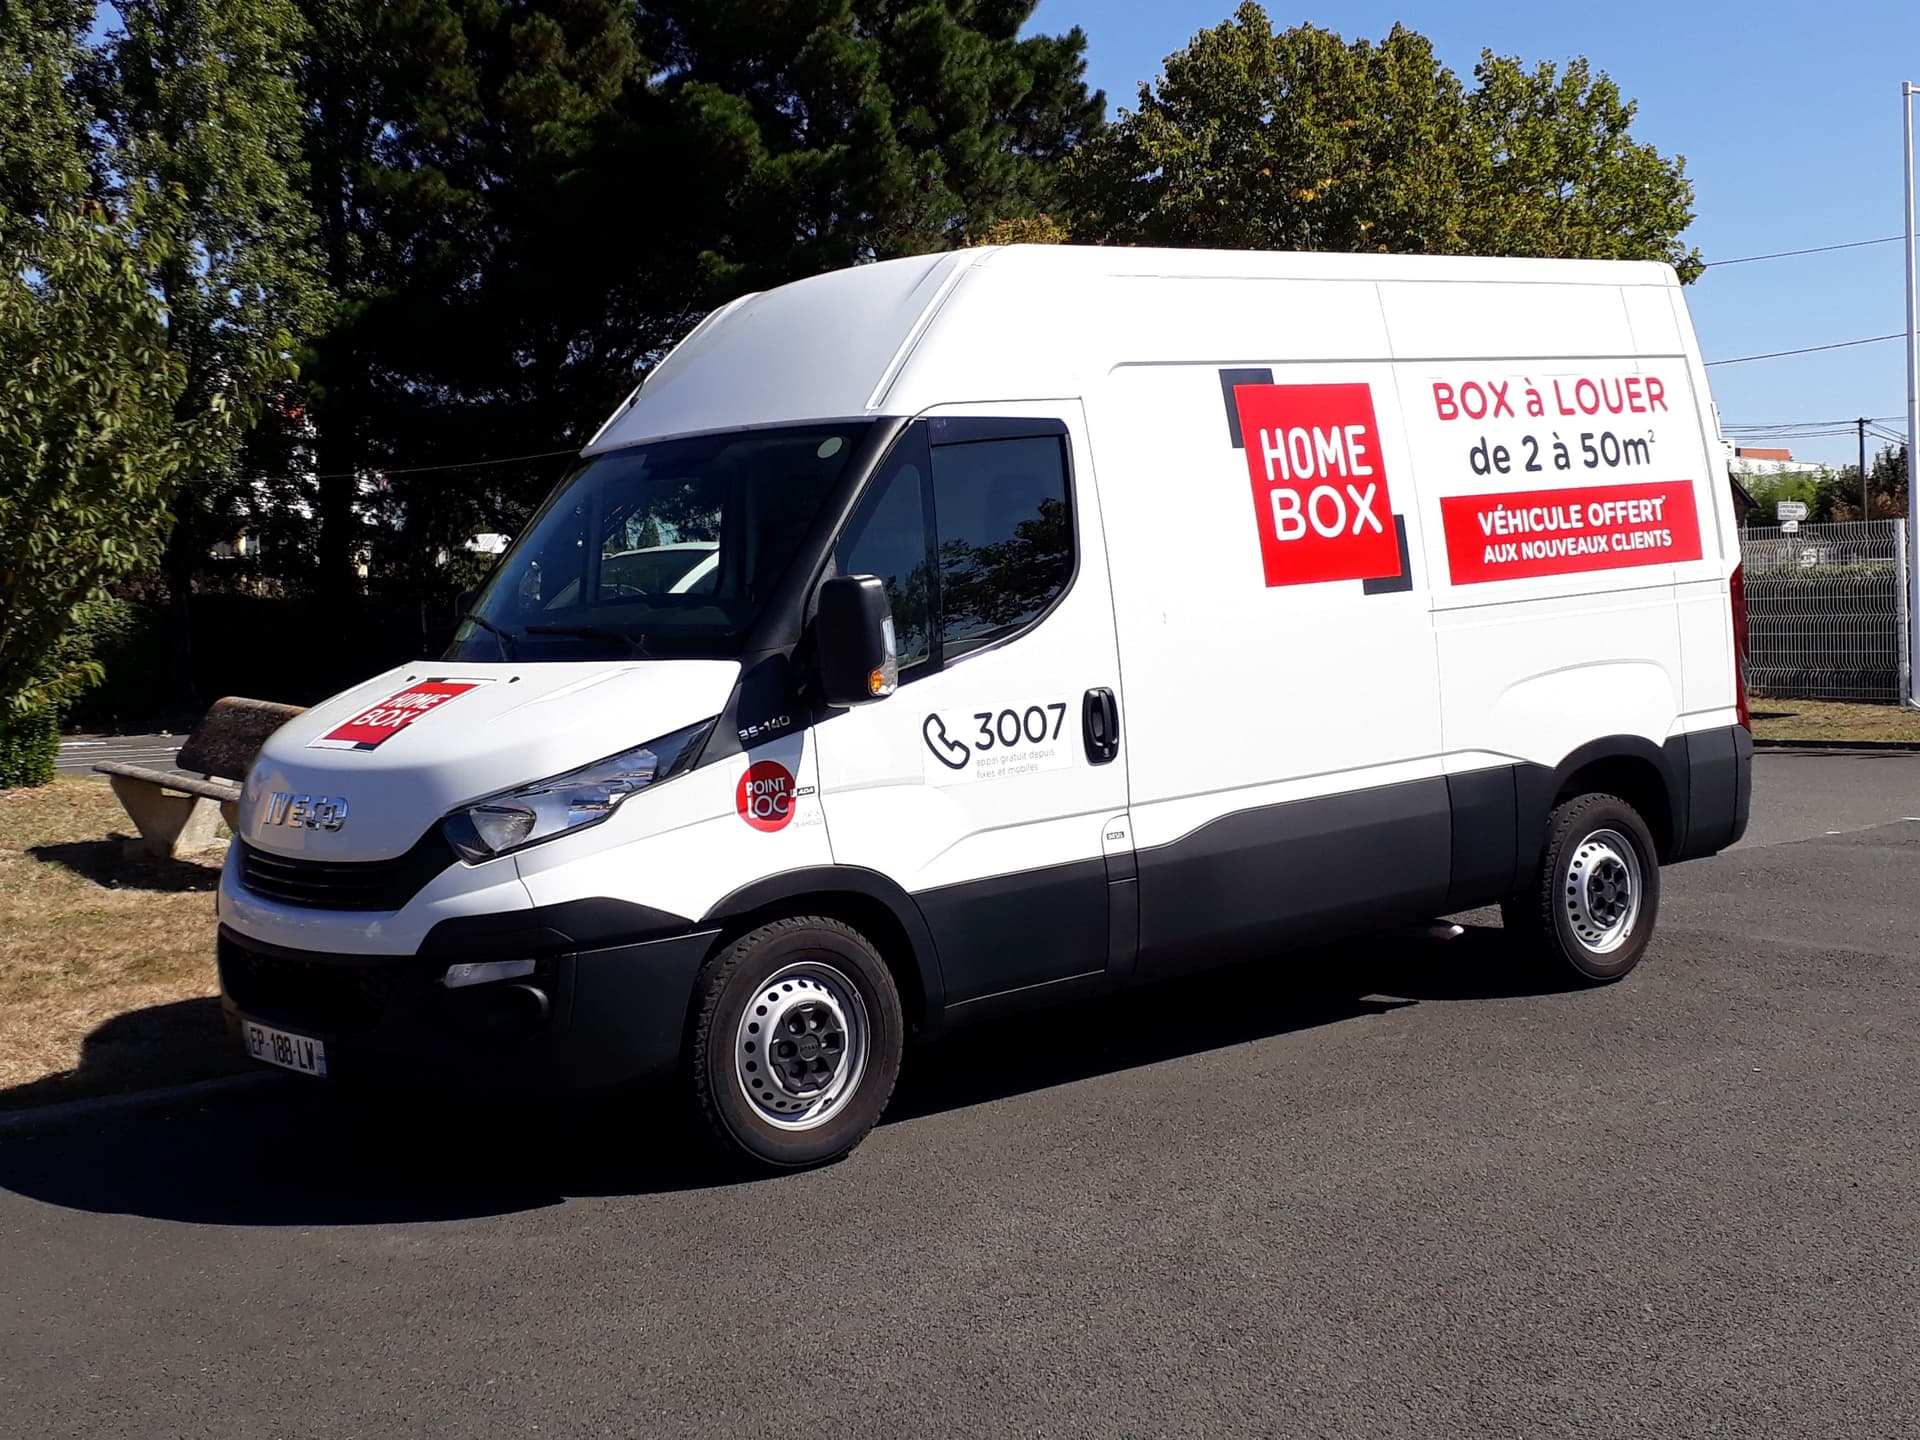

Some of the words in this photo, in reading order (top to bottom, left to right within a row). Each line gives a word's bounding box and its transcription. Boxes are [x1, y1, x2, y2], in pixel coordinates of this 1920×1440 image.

[1432, 381, 1515, 420] BOX
[1524, 377, 1544, 417] à
[1553, 377, 1668, 415] LOUER
[1260, 424, 1374, 481] HOME
[1469, 436, 1511, 475] de
[1522, 435, 1542, 472] 2
[1553, 432, 1571, 470] à
[1270, 482, 1382, 541] BOX
[1477, 503, 1584, 536] VÉHICULE
[1484, 543, 1519, 564] AUX
[1521, 535, 1609, 560] NOUVEAUX
[1611, 529, 1672, 551] CLIENTS
[352, 709, 420, 727] BOX
[738, 715, 791, 741] 35-140
[973, 702, 1067, 750] 3007
[746, 777, 785, 796] POINT
[997, 767, 1006, 777] et
[264, 791, 350, 832] IVECO
[747, 792, 789, 819] LOC
